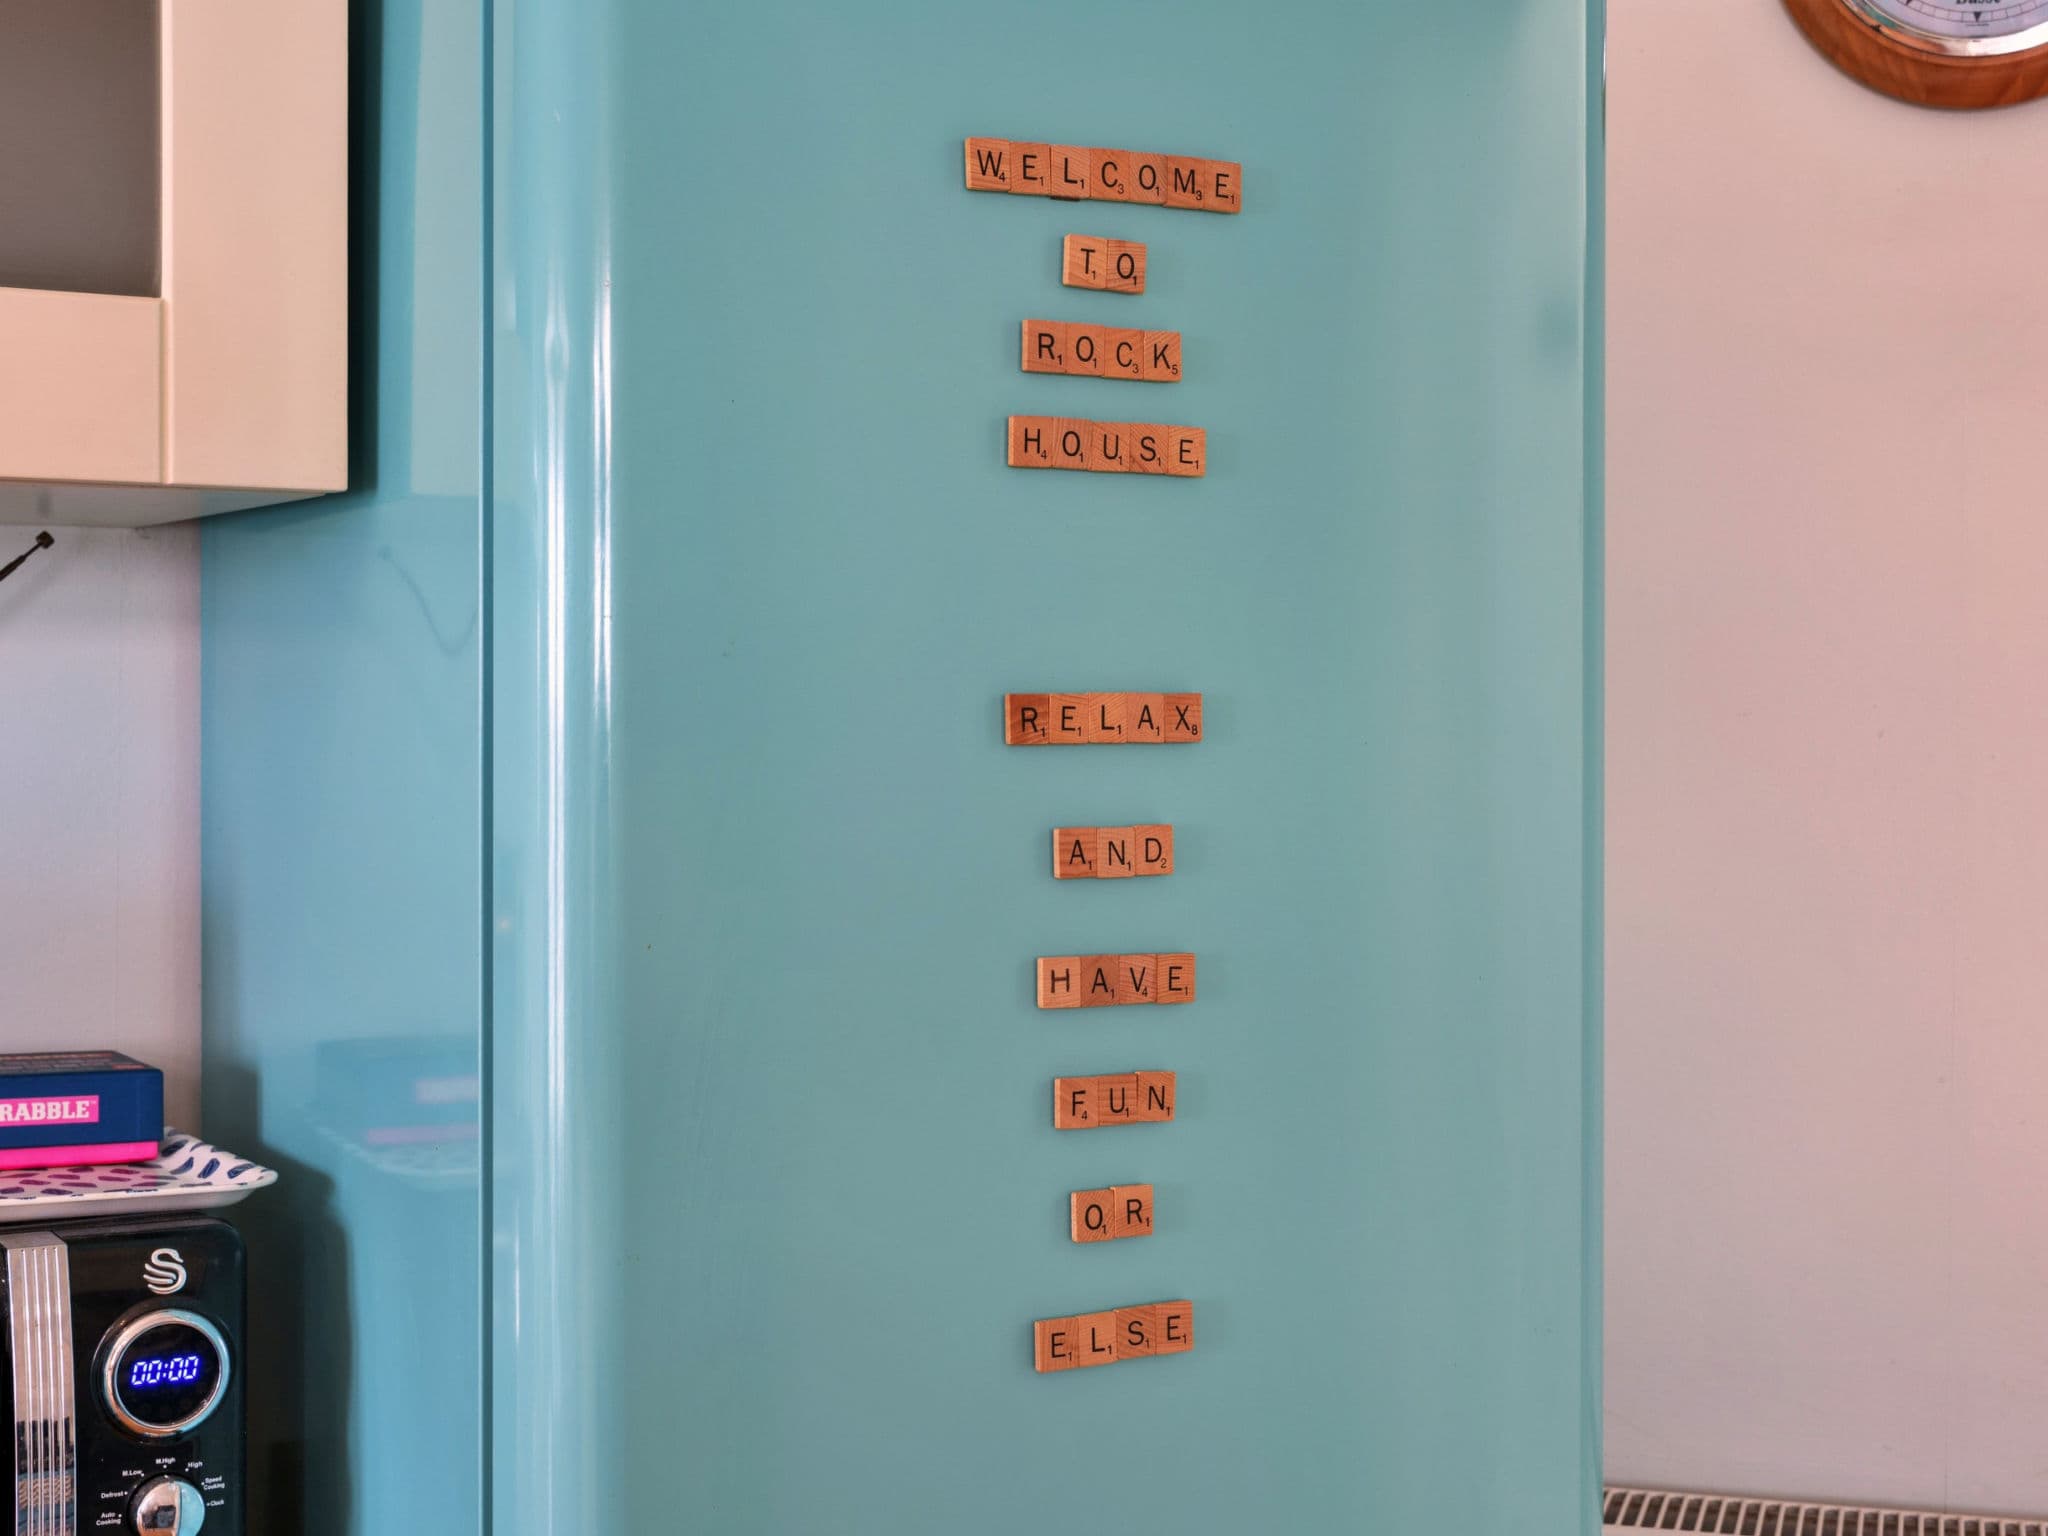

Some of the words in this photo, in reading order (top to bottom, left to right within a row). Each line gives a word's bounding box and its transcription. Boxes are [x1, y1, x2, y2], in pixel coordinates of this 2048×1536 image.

[976, 149, 1233, 202] WELCOME
[1080, 247, 1137, 284] TO
[1037, 332, 1176, 373] ROCK
[1023, 427, 1197, 467] HOUSE
[1020, 703, 1196, 736] RELAX
[1068, 837, 1166, 869] AND
[1049, 965, 1187, 997] HAVE
[0, 1100, 90, 1122] RABBLE
[1071, 1085, 1169, 1119] FUN
[1084, 1198, 1148, 1233] OR
[1050, 1314, 1185, 1360] ELSE
[132, 1356, 198, 1385] 00:00
